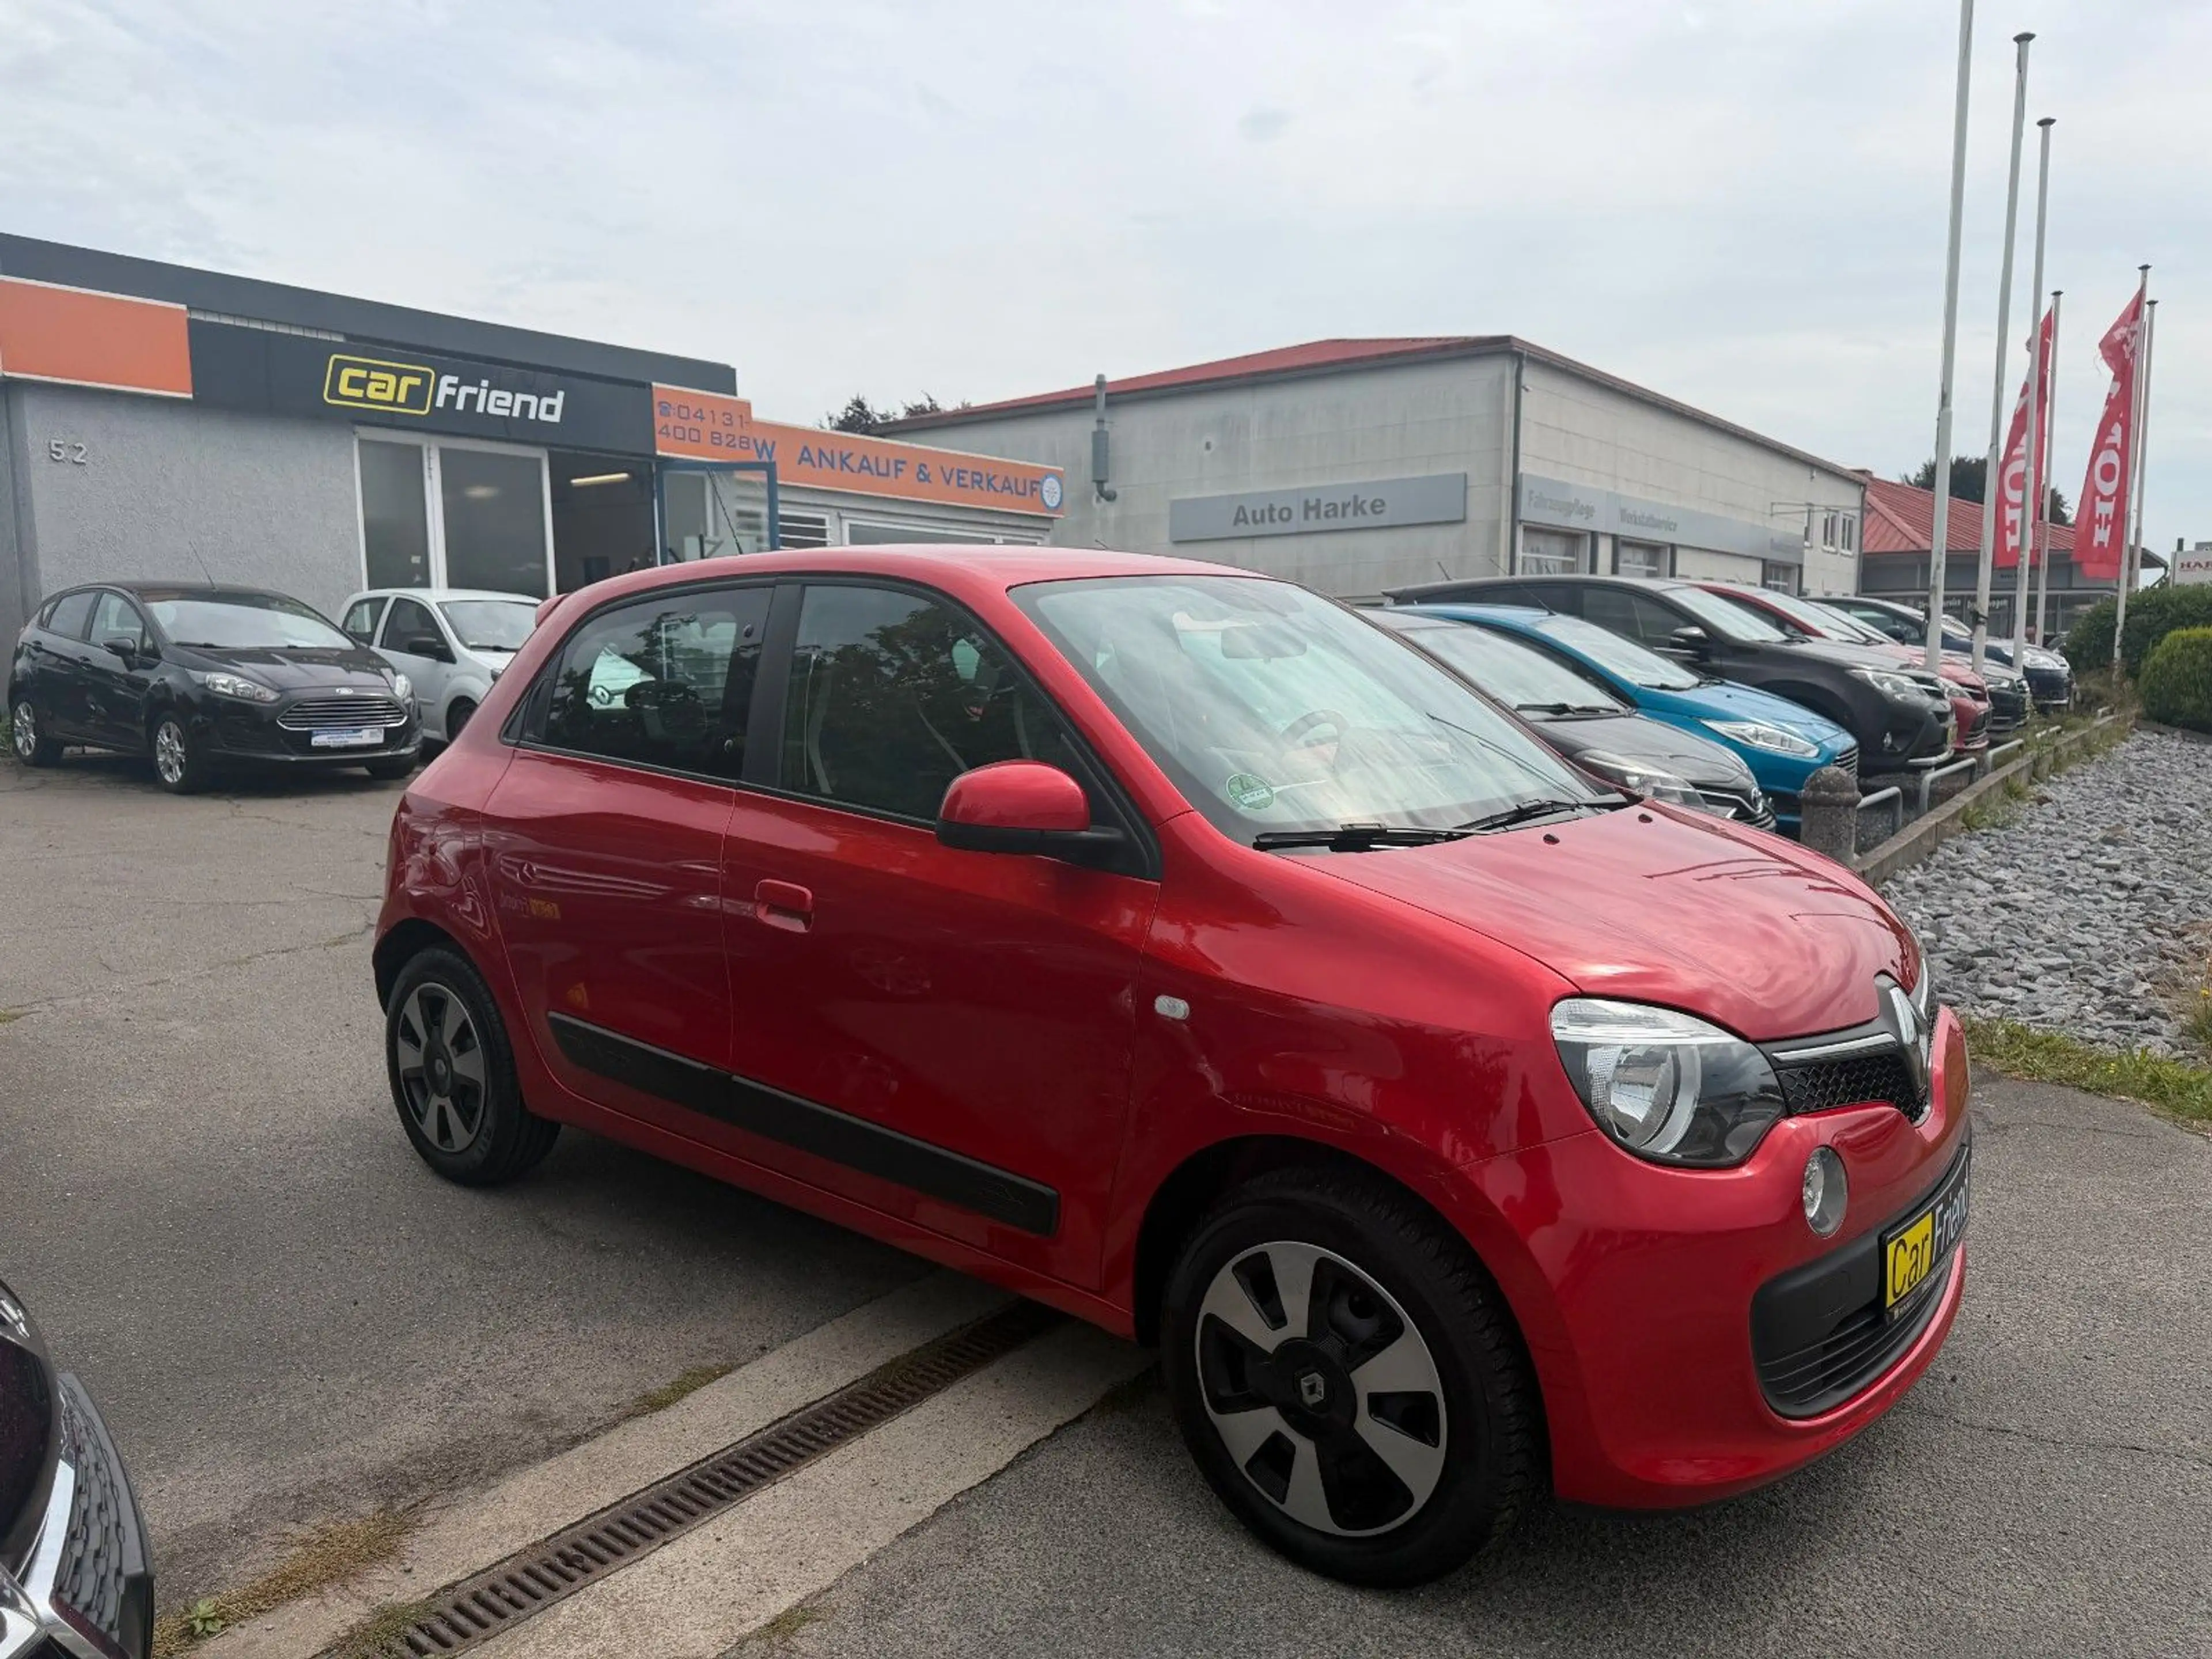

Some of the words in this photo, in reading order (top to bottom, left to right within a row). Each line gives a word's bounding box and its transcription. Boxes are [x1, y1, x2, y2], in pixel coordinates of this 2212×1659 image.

[338, 368, 422, 403] car
[435, 374, 565, 423] friend
[658, 424, 700, 444] 400
[797, 445, 907, 479] ANKAUF
[916, 463, 932, 484] &
[940, 464, 1041, 497] VERKAUF
[1233, 503, 1293, 527] Auto
[1302, 494, 1386, 521] Harke
[1892, 1232, 1930, 1298] Car
